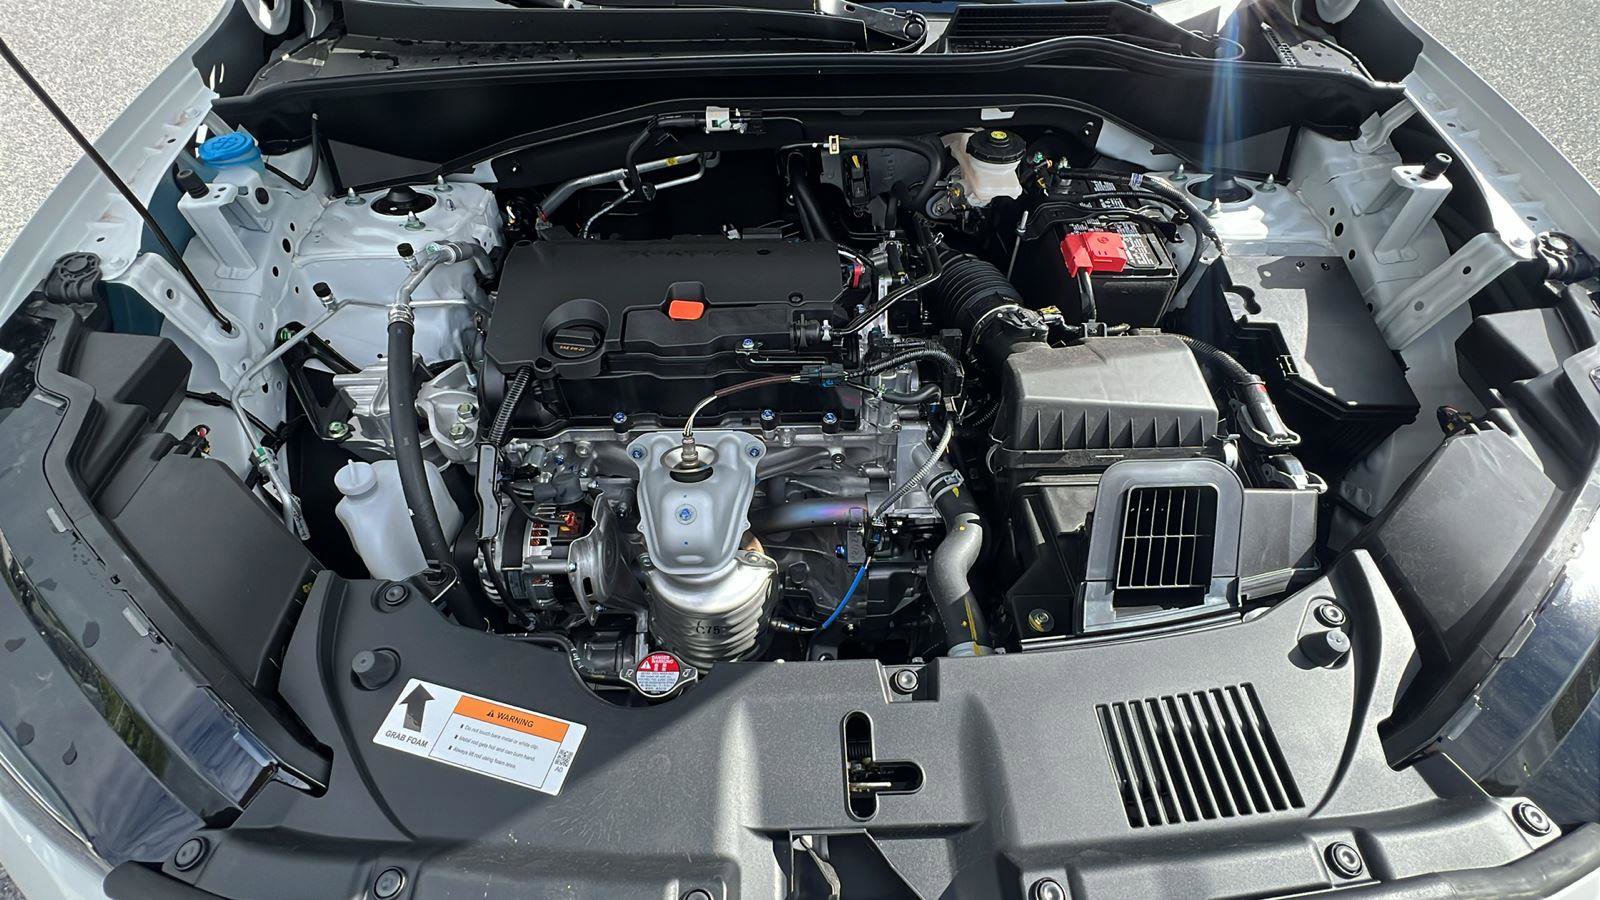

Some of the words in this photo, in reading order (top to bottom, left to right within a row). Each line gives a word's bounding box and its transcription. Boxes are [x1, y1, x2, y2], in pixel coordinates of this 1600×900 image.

[497, 712, 534, 728] WARNING
[385, 730, 406, 742] GRAB
[405, 735, 428, 748] FOAM
